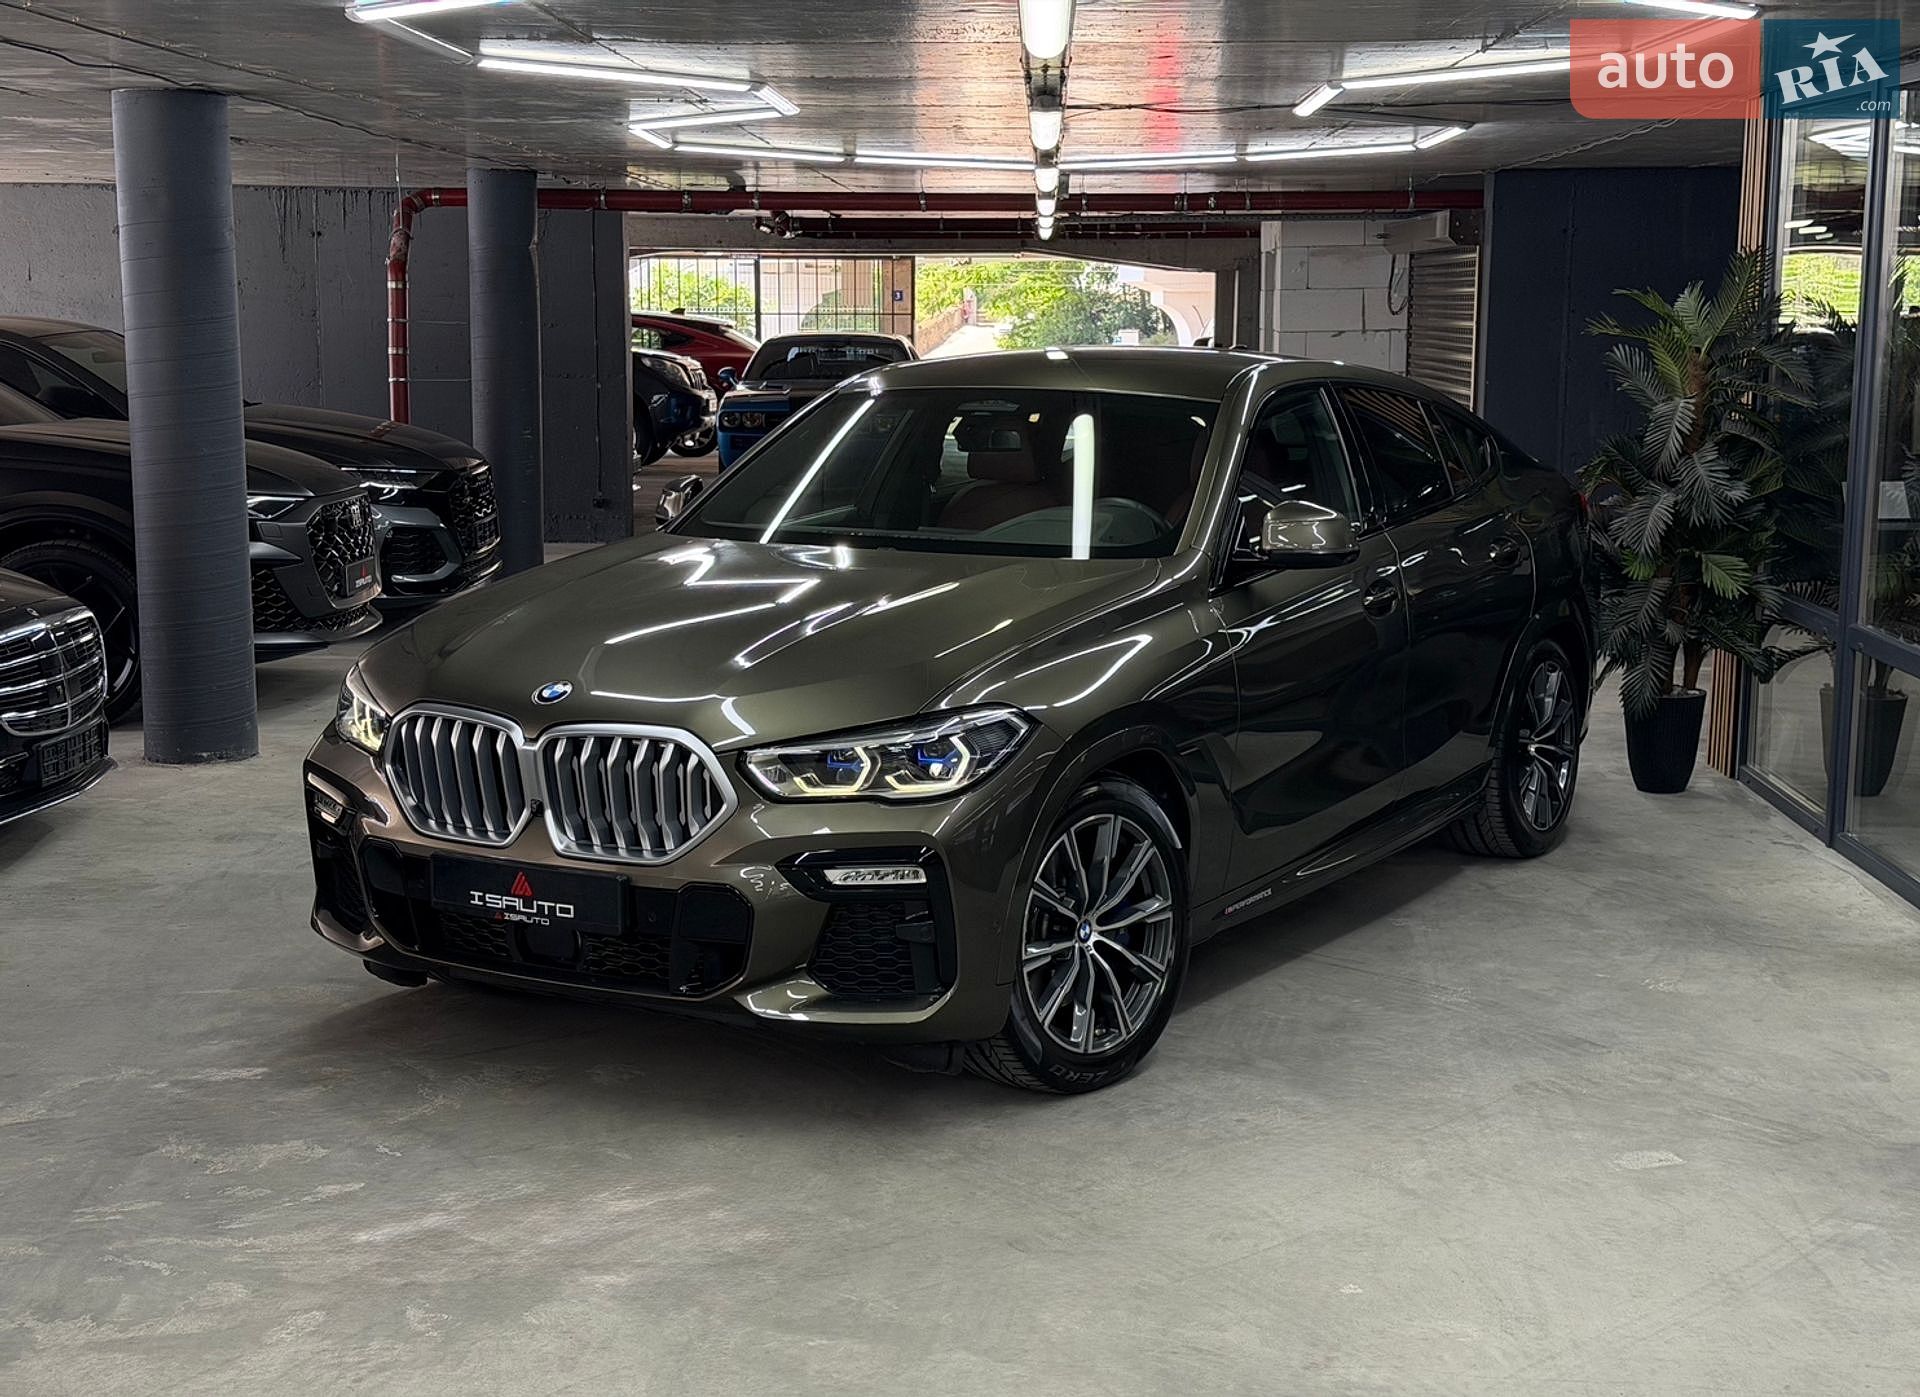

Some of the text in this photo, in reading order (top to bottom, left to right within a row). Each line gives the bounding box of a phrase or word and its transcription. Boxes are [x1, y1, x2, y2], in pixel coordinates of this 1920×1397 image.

[469, 890, 575, 919] ISAUTO
[503, 911, 550, 926] ISAUTO
[1048, 1063, 1110, 1084] ZERO
